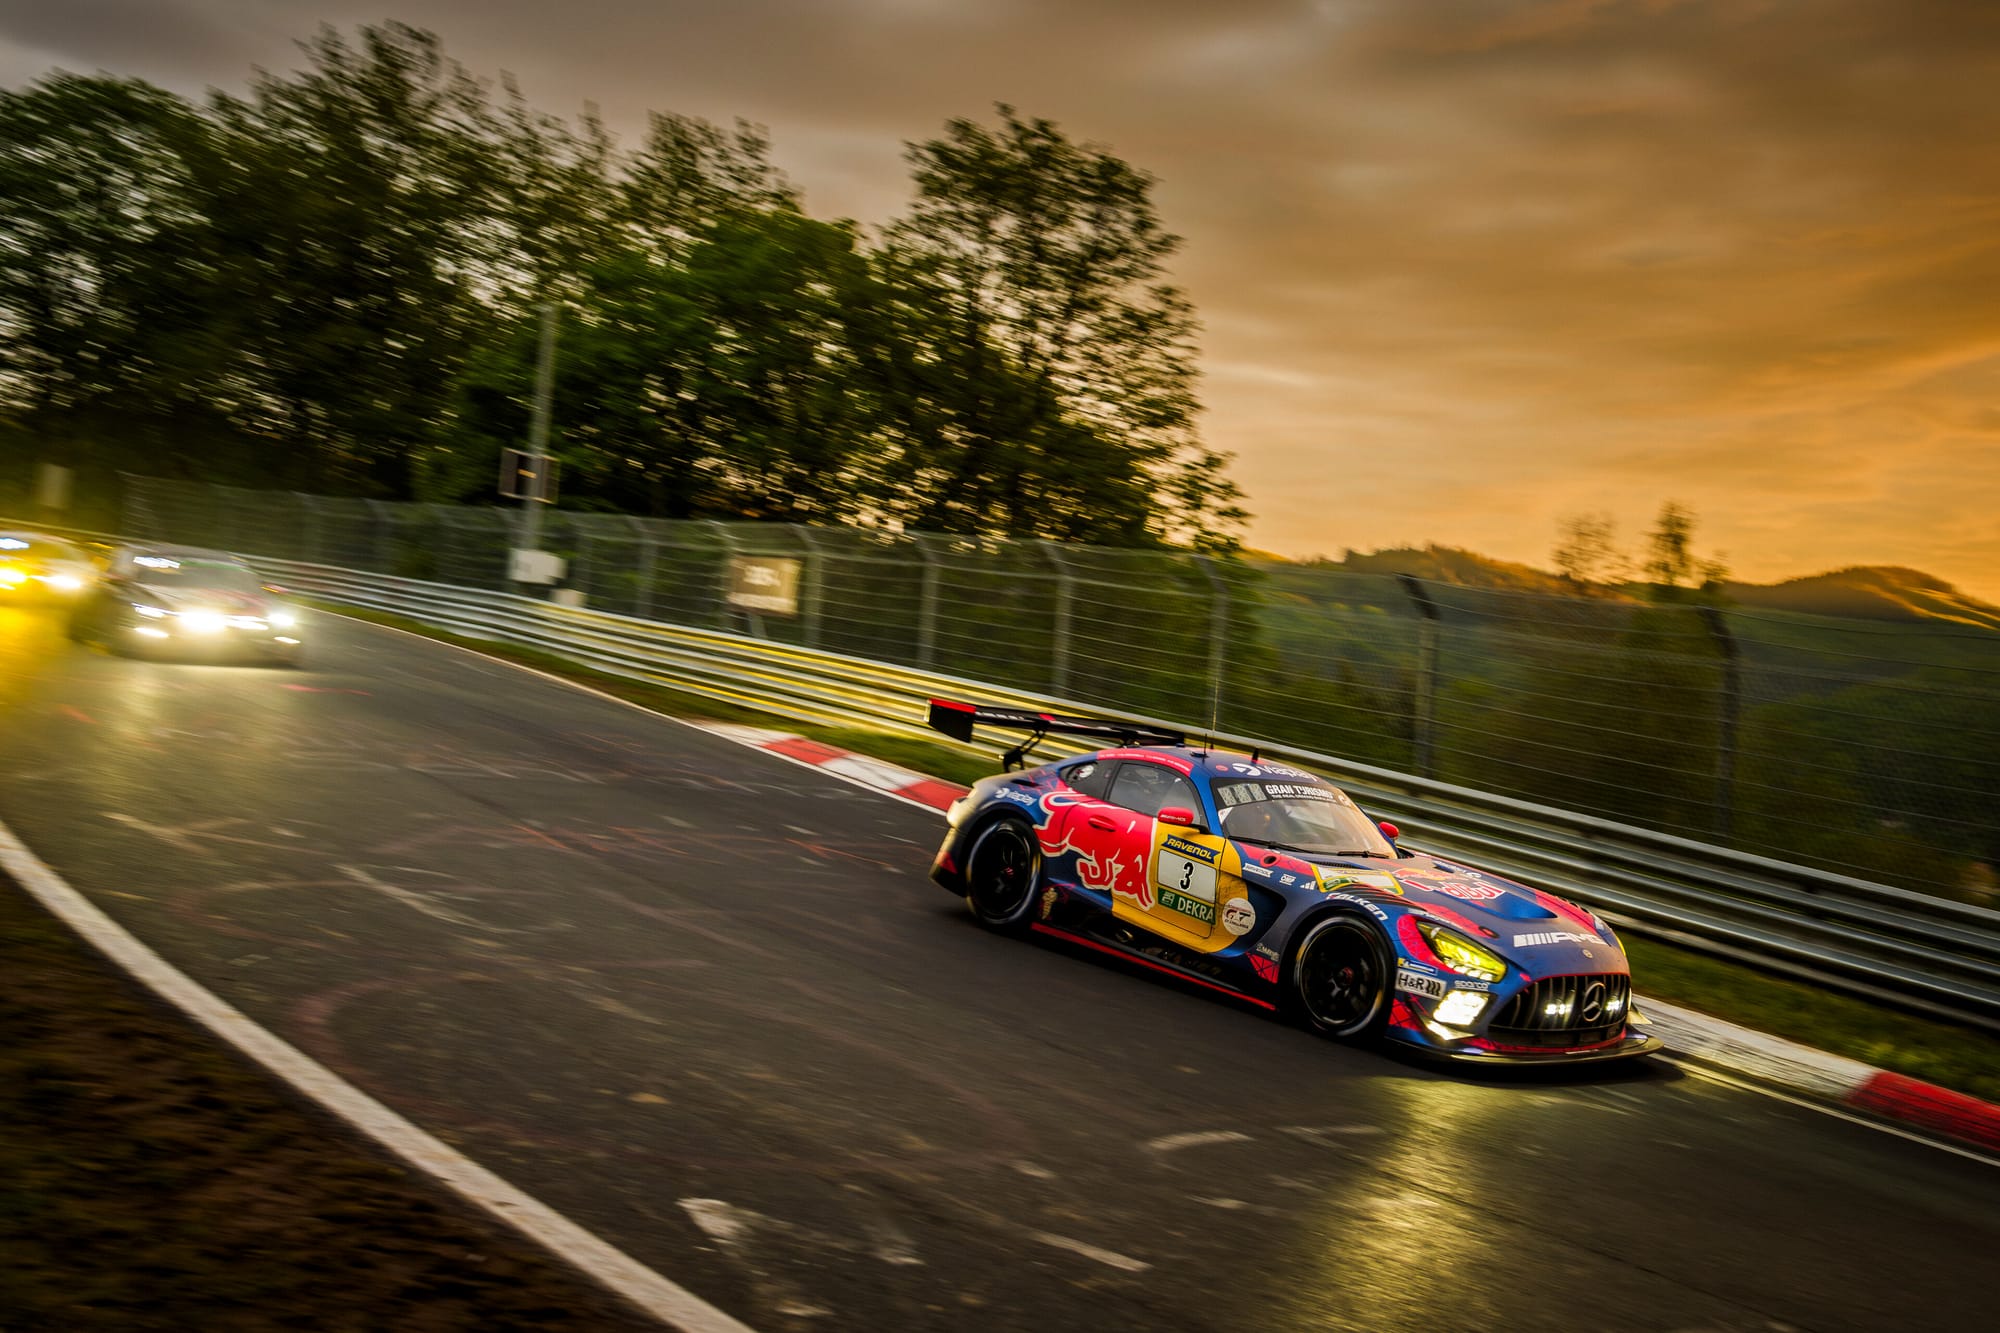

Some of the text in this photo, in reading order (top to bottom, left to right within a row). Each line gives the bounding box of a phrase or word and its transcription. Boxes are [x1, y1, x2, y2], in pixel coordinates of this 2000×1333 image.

[1265, 784, 1295, 795] GRAN
[1293, 785, 1334, 800] TURISMO
[1167, 838, 1212, 860] RAVENOL
[1179, 861, 1194, 890] 3
[1177, 897, 1214, 921] DEKRA
[1326, 892, 1389, 921] FALKEN
[1398, 972, 1425, 991] H&R
[1454, 980, 1490, 991] sparco
